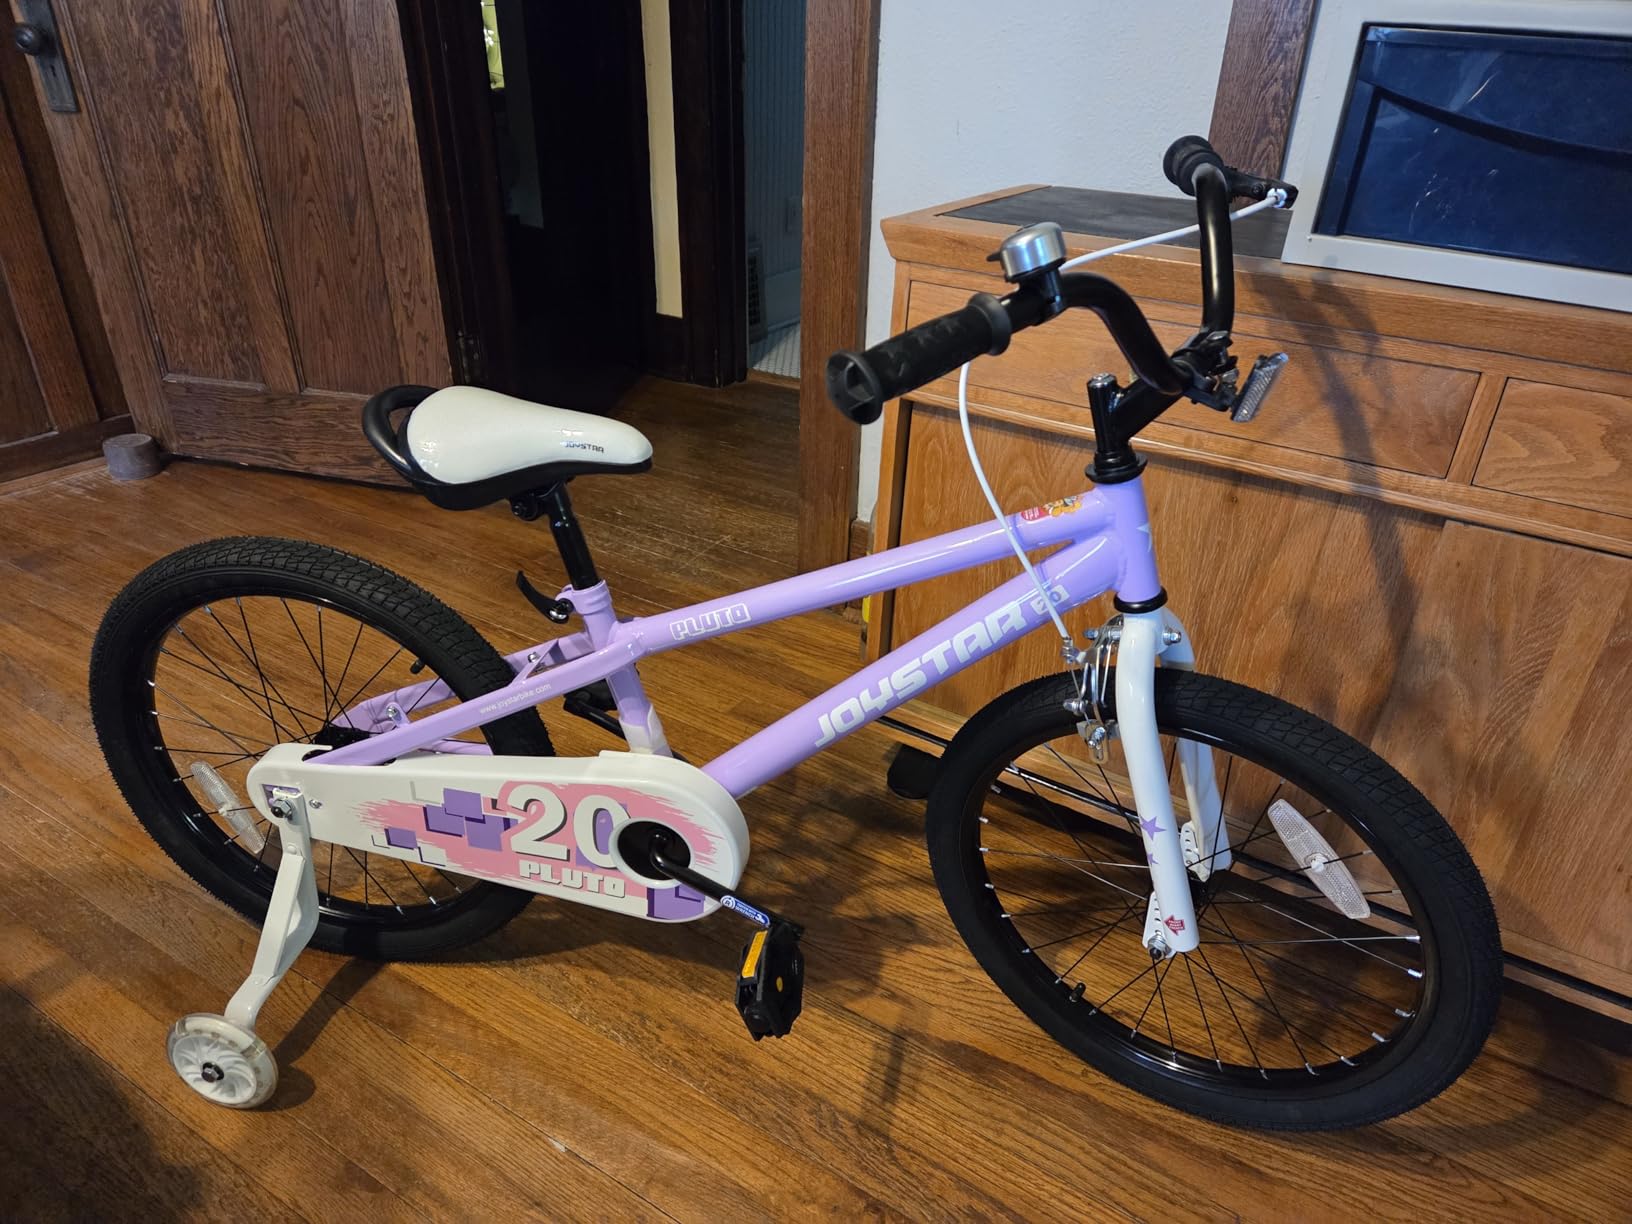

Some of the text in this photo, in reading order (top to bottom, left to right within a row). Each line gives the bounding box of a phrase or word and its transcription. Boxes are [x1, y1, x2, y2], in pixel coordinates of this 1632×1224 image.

[563, 440, 605, 453] JOYSTAR
[669, 603, 752, 641] PLUTO
[814, 600, 1028, 748] JOYSTAR
[507, 783, 631, 868] 20
[519, 859, 626, 898] PLUTO
